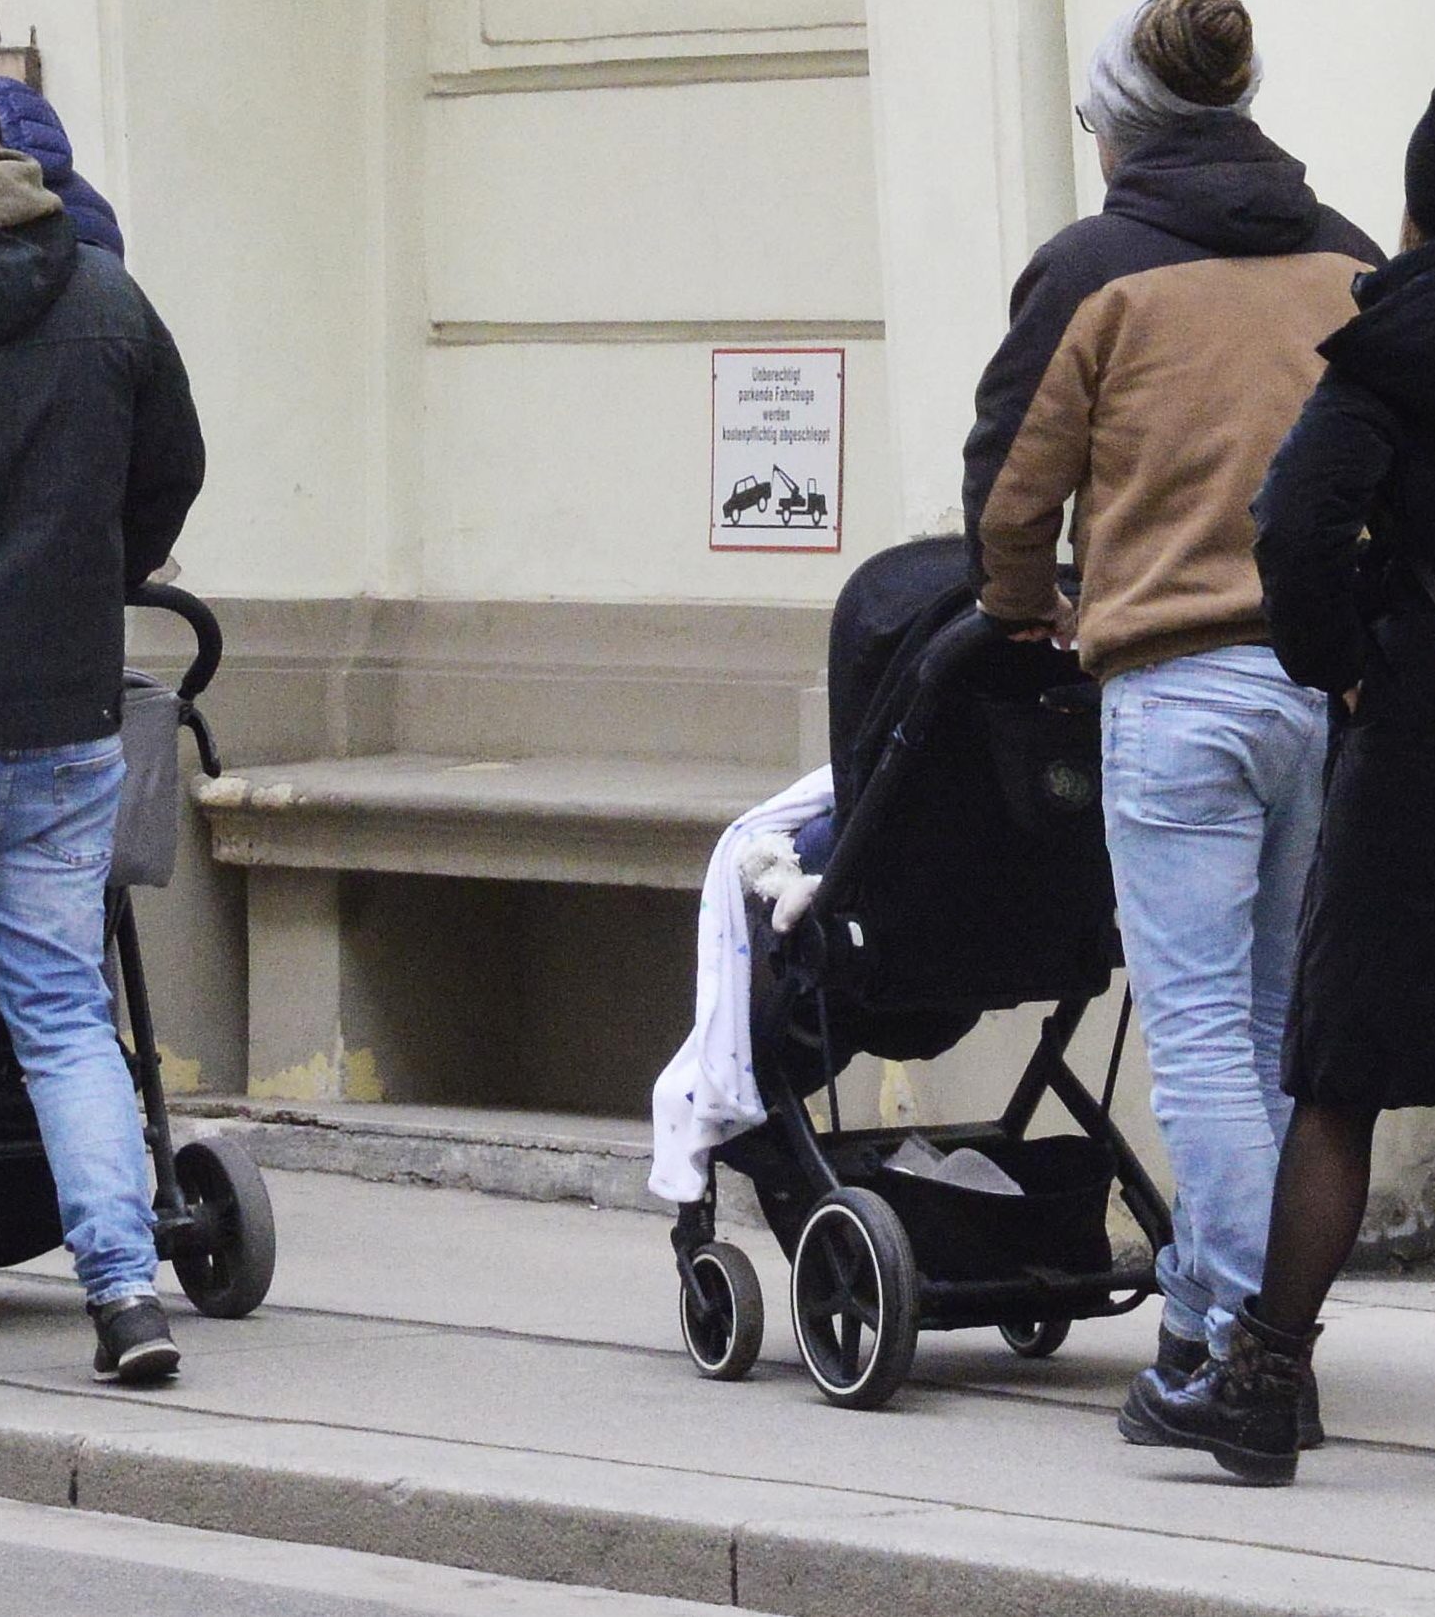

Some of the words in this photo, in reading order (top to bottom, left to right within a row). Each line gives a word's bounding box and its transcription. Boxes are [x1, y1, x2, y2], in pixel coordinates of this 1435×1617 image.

[752, 366, 801, 385] Unberechtigt
[738, 386, 773, 405] parkende
[775, 386, 814, 405] Fahrzeuge
[763, 407, 790, 421] werden
[723, 426, 777, 445] kostenpflichtig
[779, 426, 830, 445] abgeschleppt
